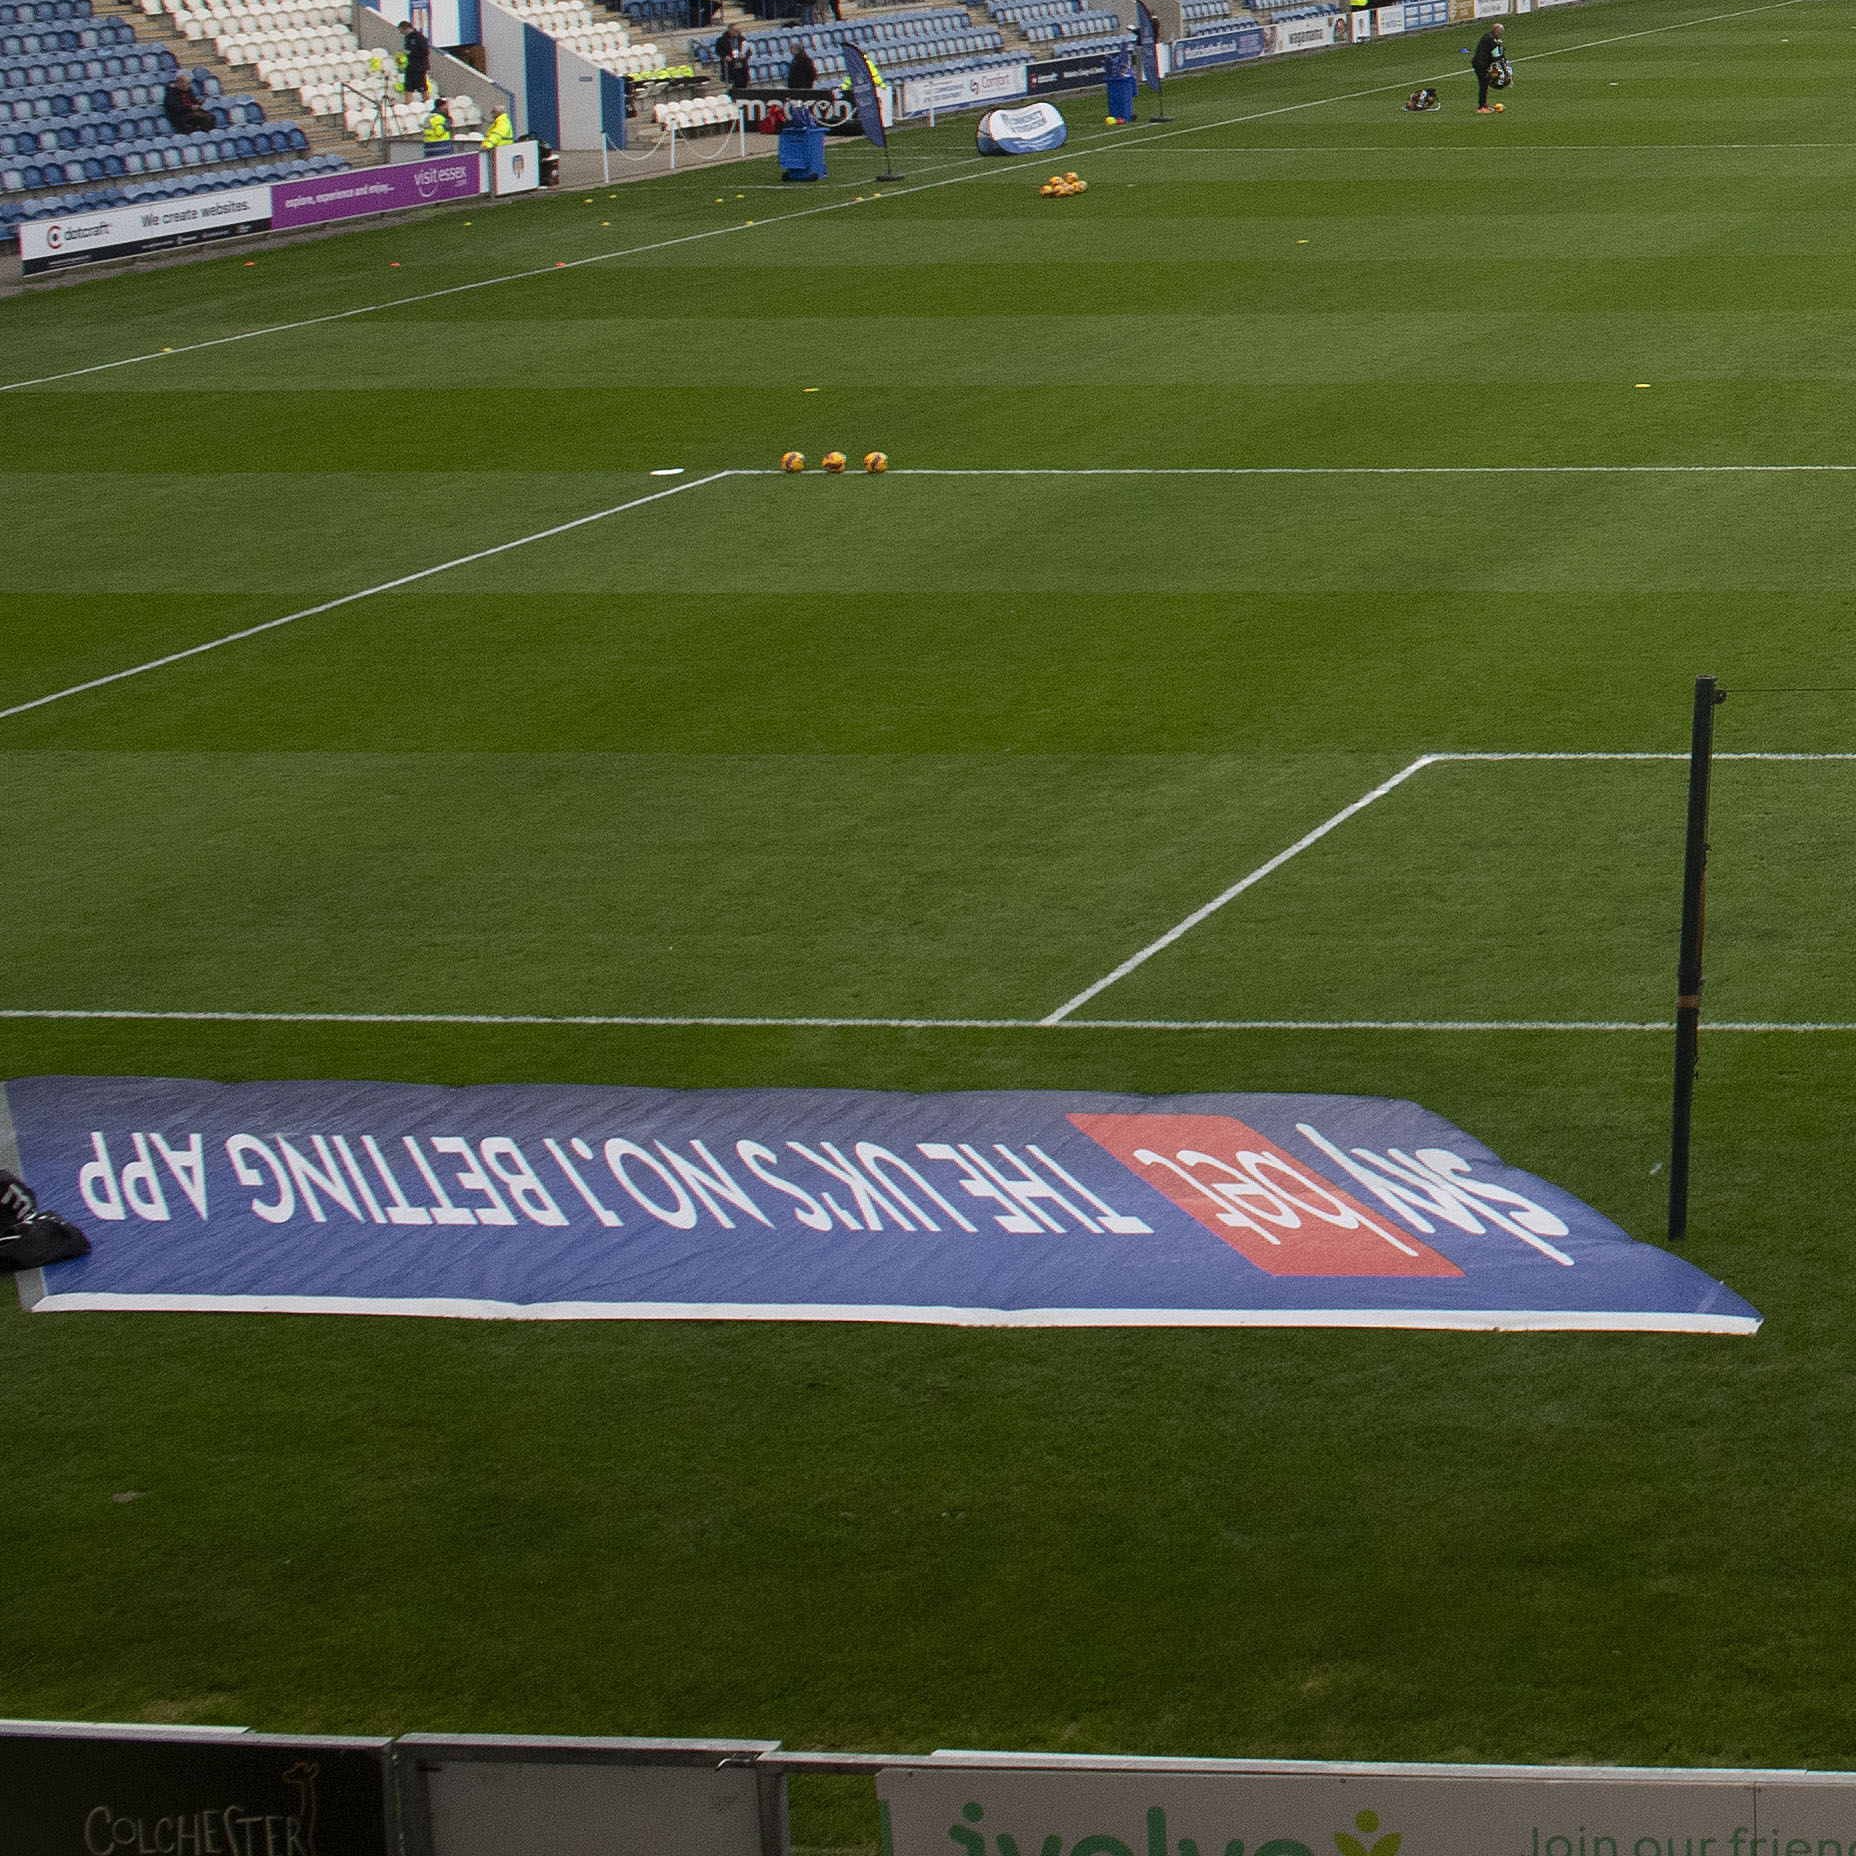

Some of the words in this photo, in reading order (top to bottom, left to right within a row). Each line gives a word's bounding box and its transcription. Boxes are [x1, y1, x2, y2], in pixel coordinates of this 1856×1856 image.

[140, 214, 159, 228] We
[162, 209, 199, 224] create
[200, 200, 252, 217] websites.
[414, 168, 437, 186] visit
[438, 165, 467, 183] essex
[65, 221, 108, 241] dotcraft
[78, 1129, 212, 1222] APP
[224, 1132, 569, 1227] BETTING
[737, 1138, 978, 1234] UK'S
[916, 1142, 1152, 1235] THE
[1133, 1149, 1421, 1256] bet
[1297, 1124, 1578, 1266] sky
[84, 1804, 304, 1856] COLCHESTER
